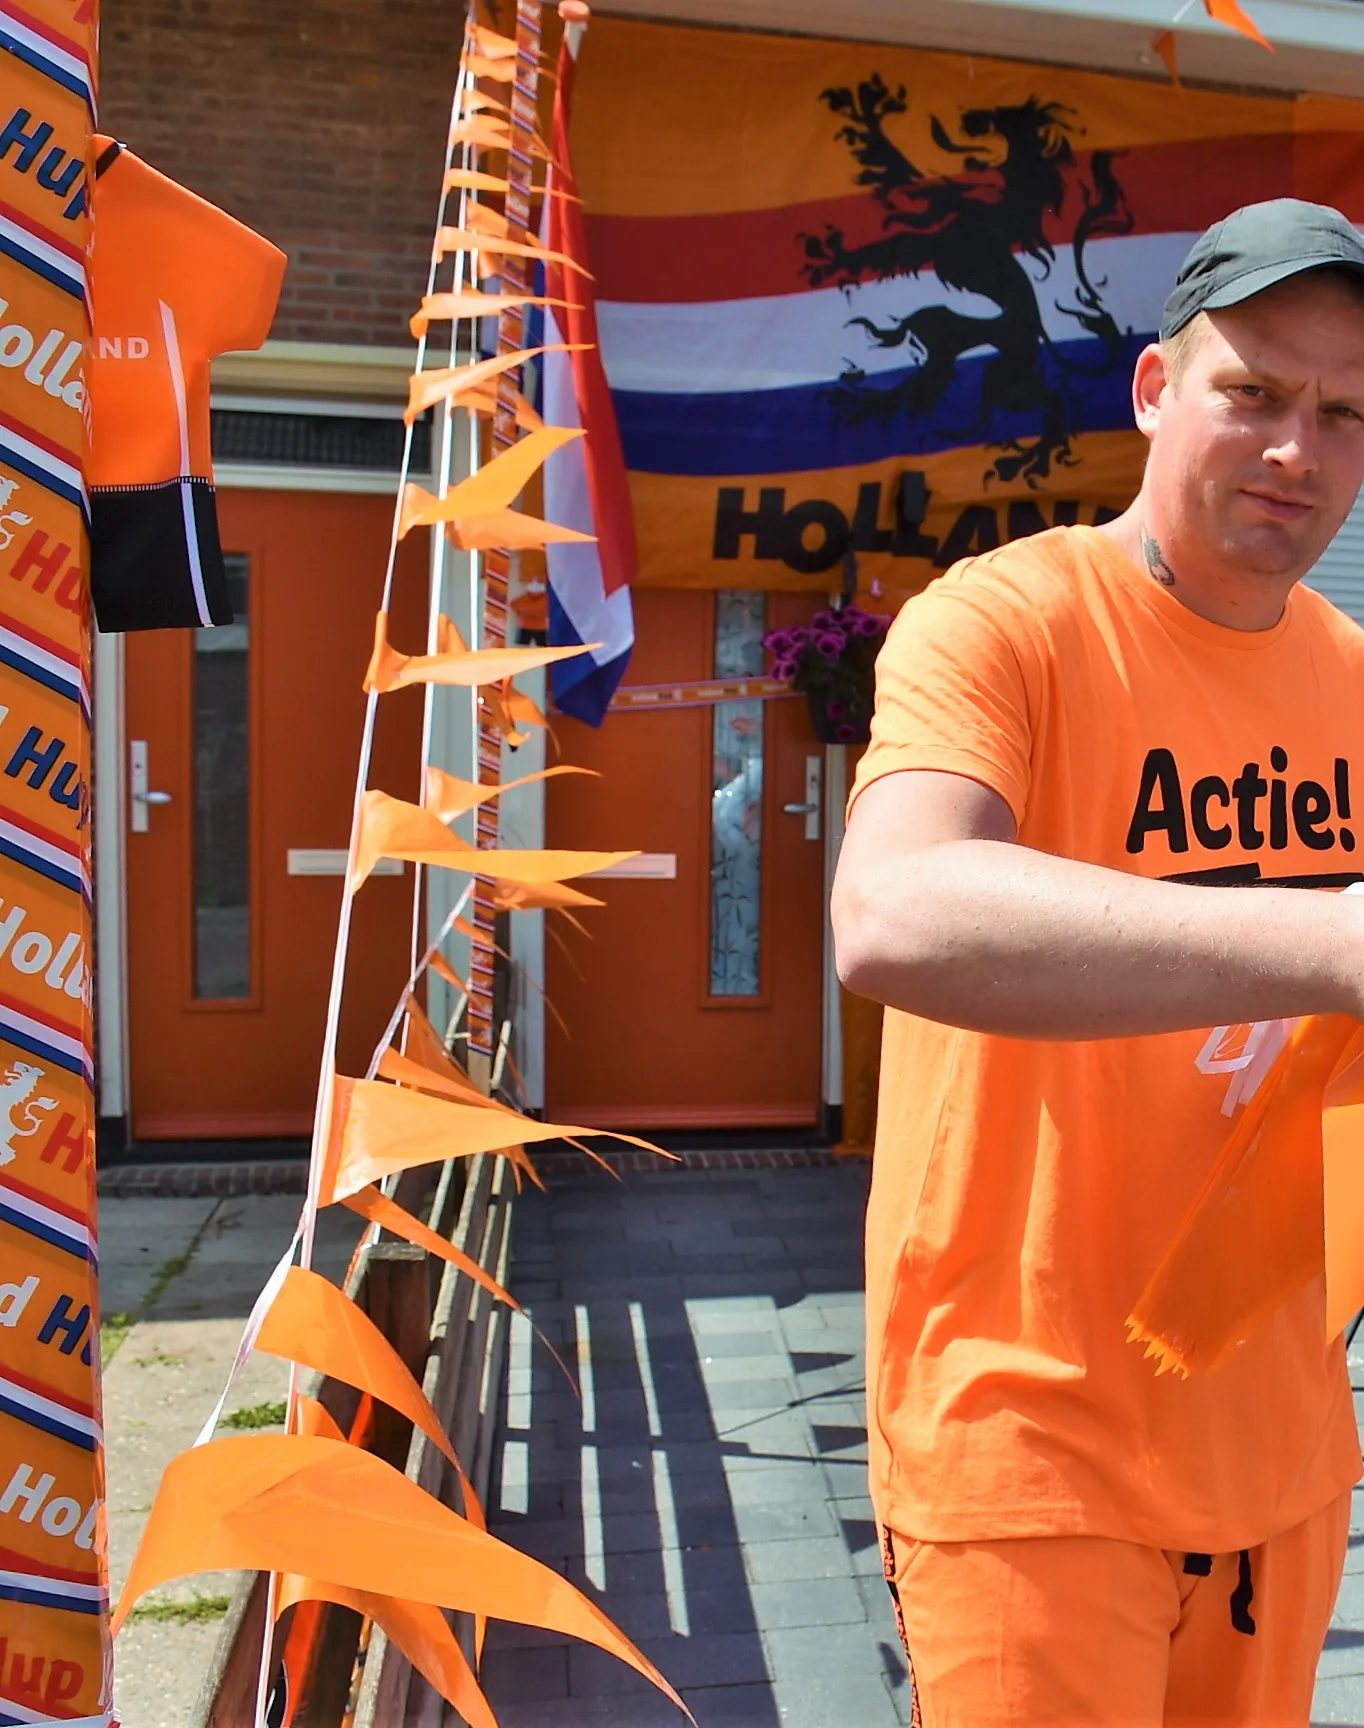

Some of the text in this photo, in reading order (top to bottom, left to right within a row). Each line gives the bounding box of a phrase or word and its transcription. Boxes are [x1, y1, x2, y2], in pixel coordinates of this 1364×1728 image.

[9, 529, 87, 622] Hu
[4, 725, 87, 820] Hu
[1126, 746, 1356, 854] Actie!
